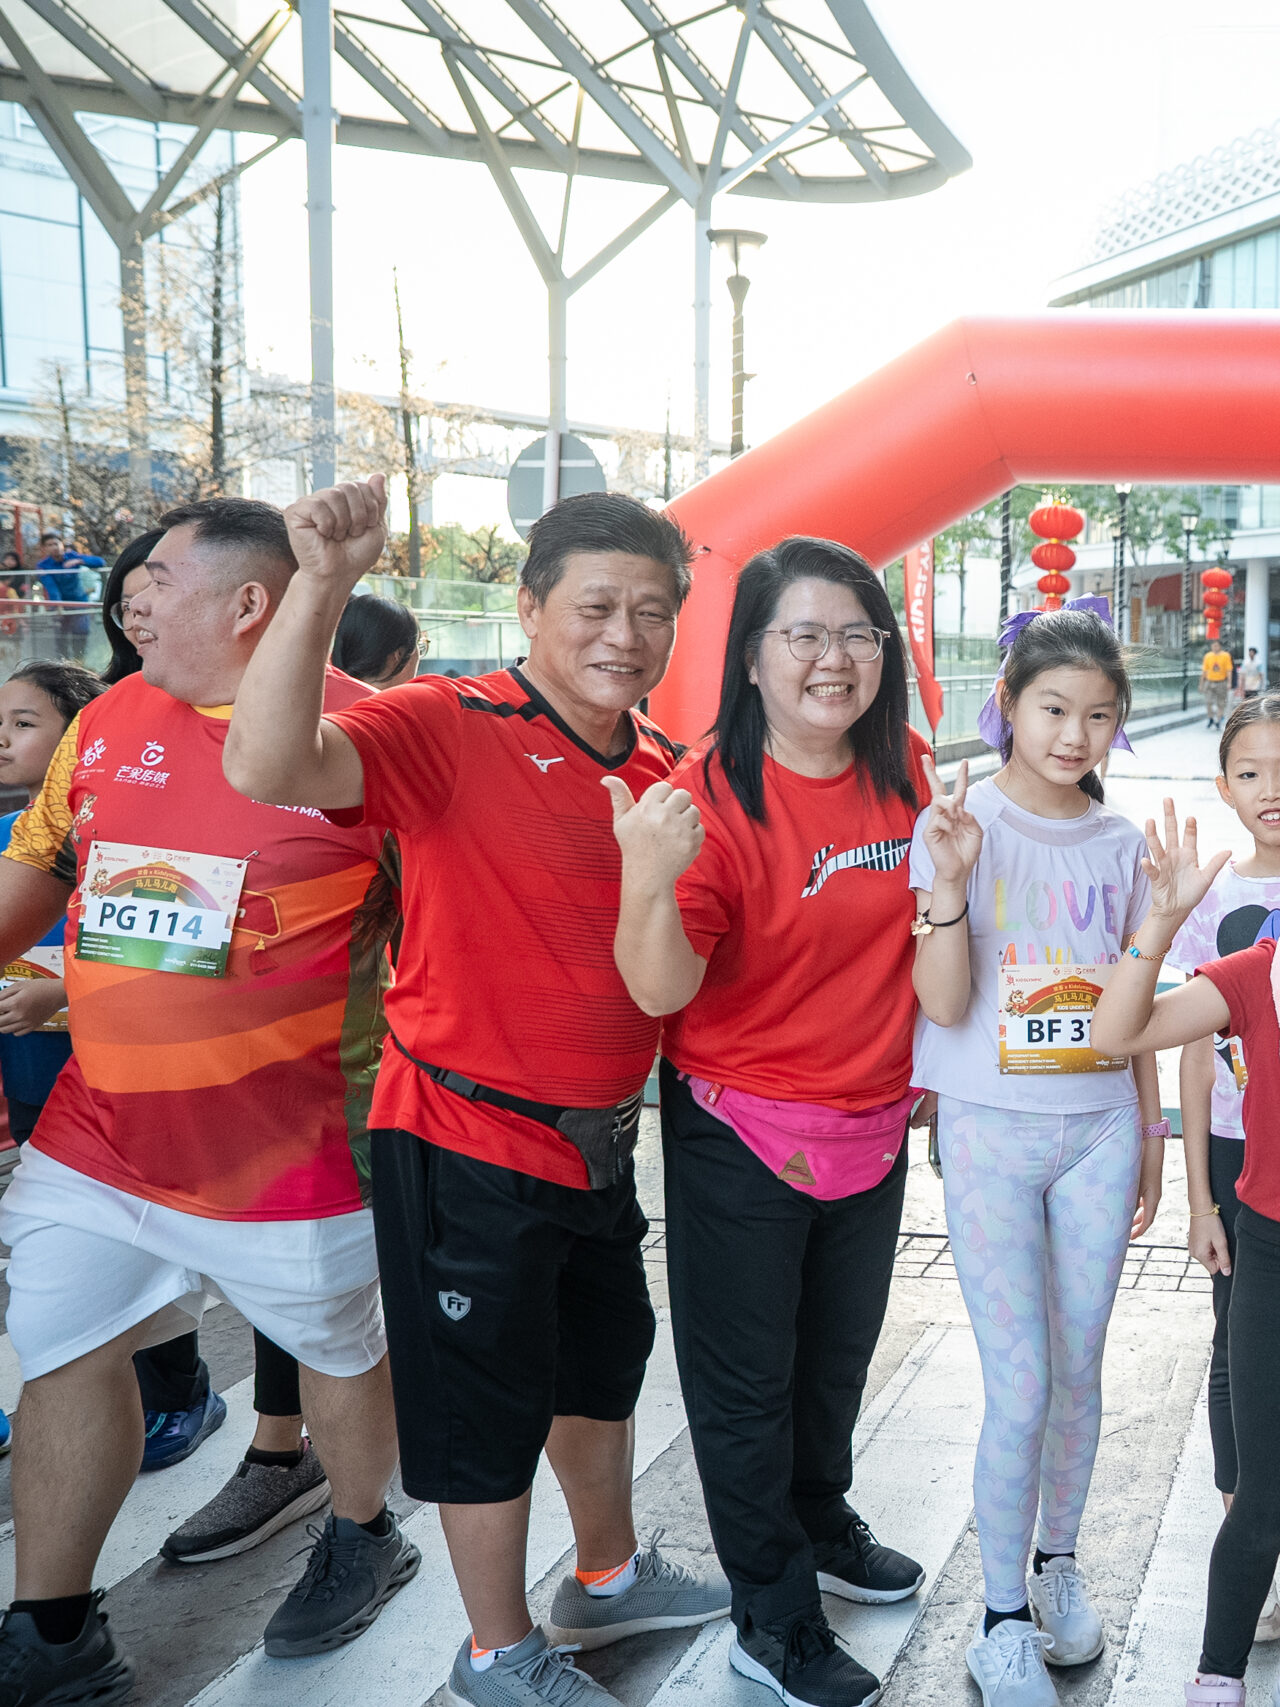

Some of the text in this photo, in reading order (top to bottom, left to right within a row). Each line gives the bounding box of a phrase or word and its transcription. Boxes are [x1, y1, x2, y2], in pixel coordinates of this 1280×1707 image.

[99, 902, 137, 930] PG
[149, 909, 203, 940] 114
[995, 879, 1118, 935] LOVE
[1028, 1019, 1091, 1042] BF 3
